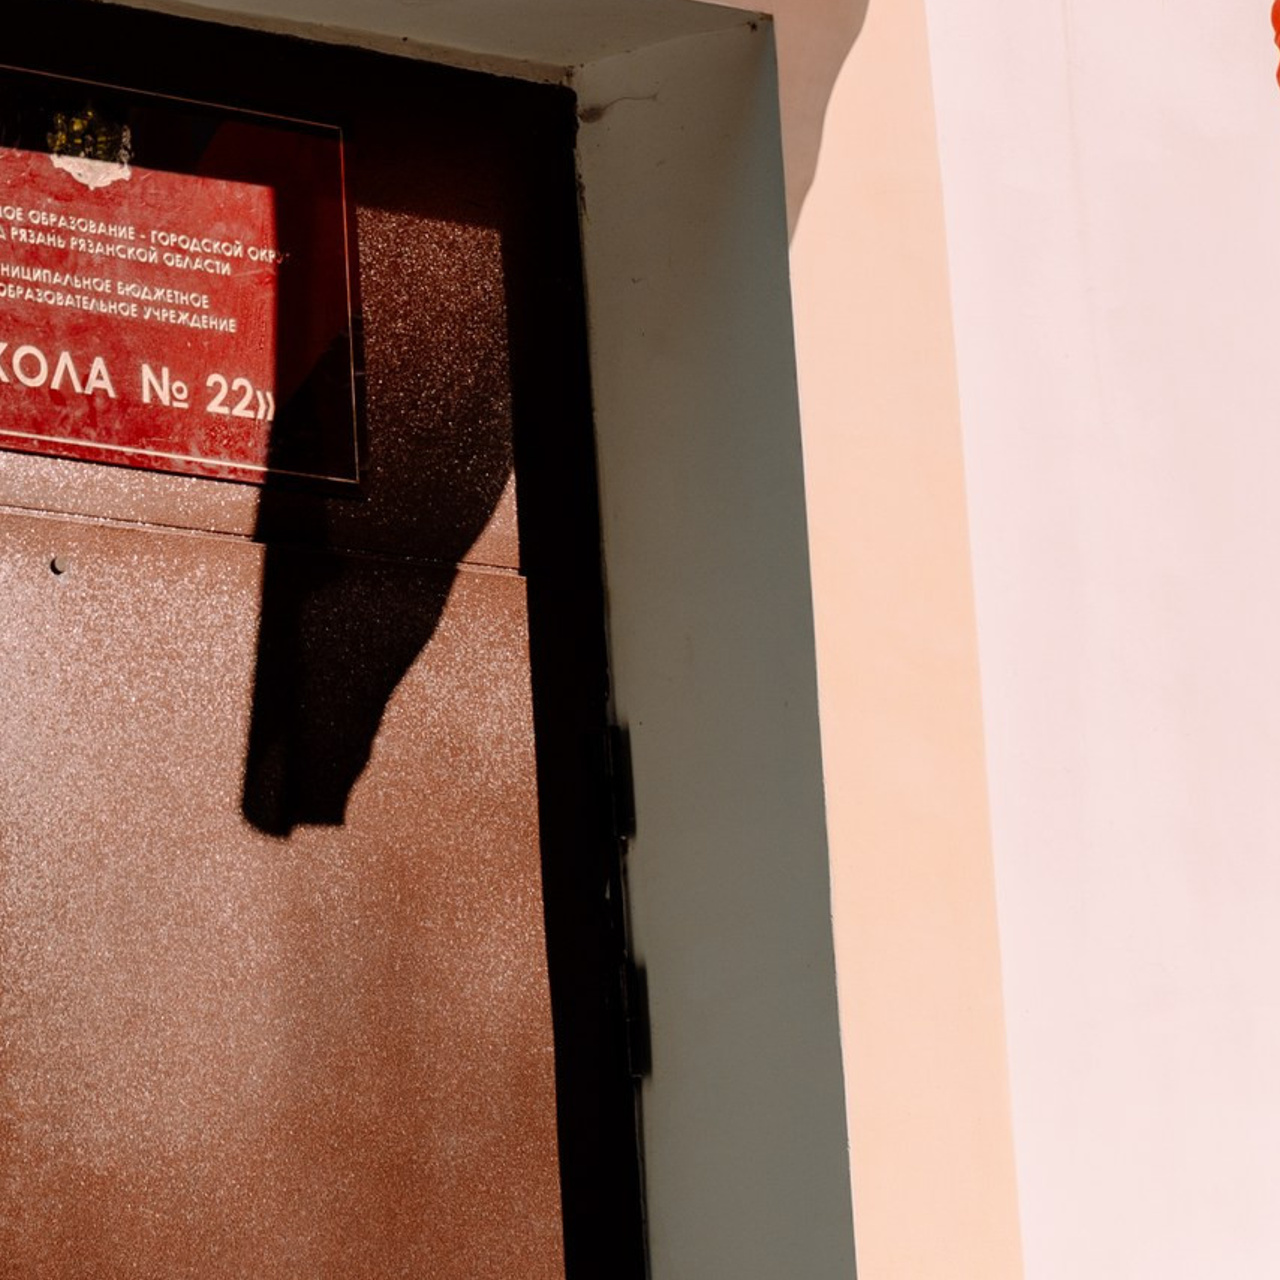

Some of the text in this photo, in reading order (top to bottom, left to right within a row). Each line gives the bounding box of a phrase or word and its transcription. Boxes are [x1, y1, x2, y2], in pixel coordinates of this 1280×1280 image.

[11, 226, 66, 249] РЯЗАНЬ
[70, 236, 158, 265] РЯЗАНСКОЙ
[163, 252, 231, 276] ОБЛАСТИ
[28, 209, 136, 241] ОБРАЗОВАНИЕ
[150, 230, 244, 258] ГОРОДСКОЙ
[247, 246, 291, 264] ОКРУ
[117, 281, 210, 309] БЮДЖЕТНОЕ
[143, 306, 238, 334] УЧРЕЖДЕНИЕ
[141, 363, 189, 409] №
[205, 373, 275, 421] 22»
